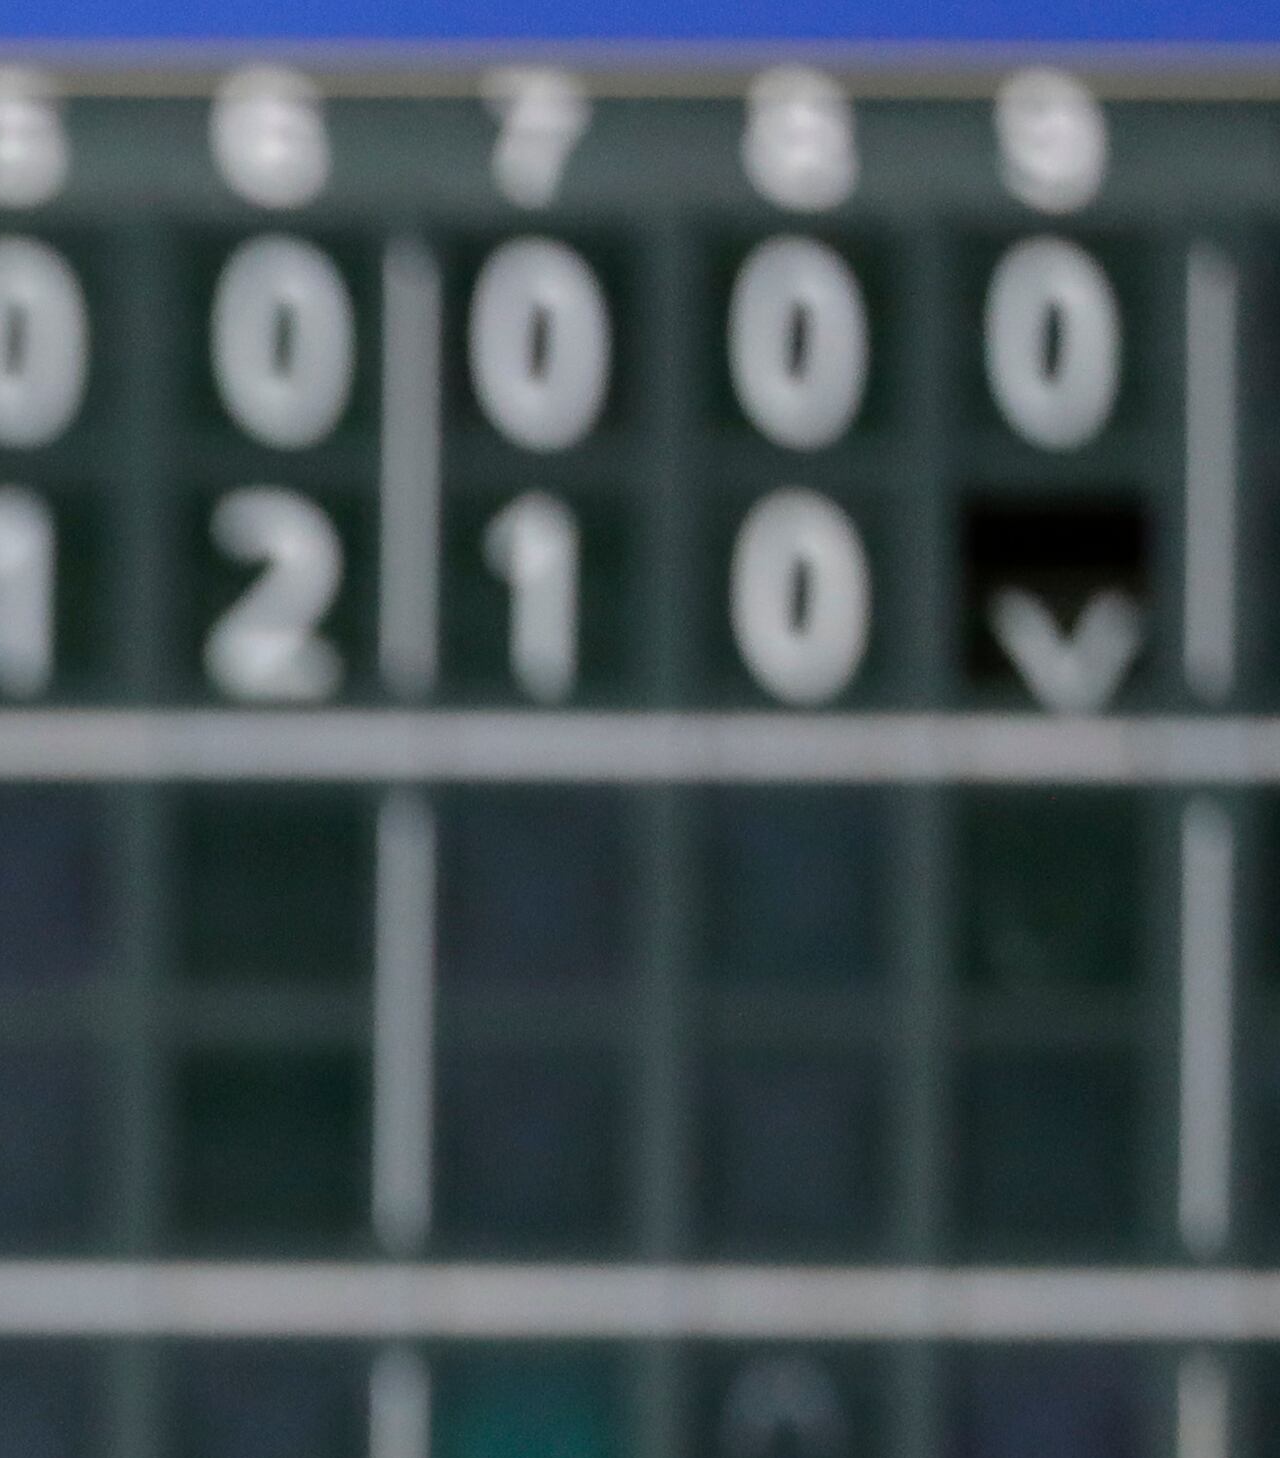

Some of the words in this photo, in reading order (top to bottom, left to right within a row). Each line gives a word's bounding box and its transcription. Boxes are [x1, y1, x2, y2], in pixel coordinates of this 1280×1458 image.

[208, 64, 330, 208] 6
[480, 65, 590, 206] 7
[742, 65, 860, 212] 8
[993, 66, 1110, 212] 9
[210, 234, 355, 450] 0
[468, 236, 611, 452] 0
[728, 235, 869, 451] 0
[984, 236, 1121, 451] 0
[204, 487, 343, 704] 2
[485, 494, 579, 702] 1
[730, 488, 870, 706] 0
